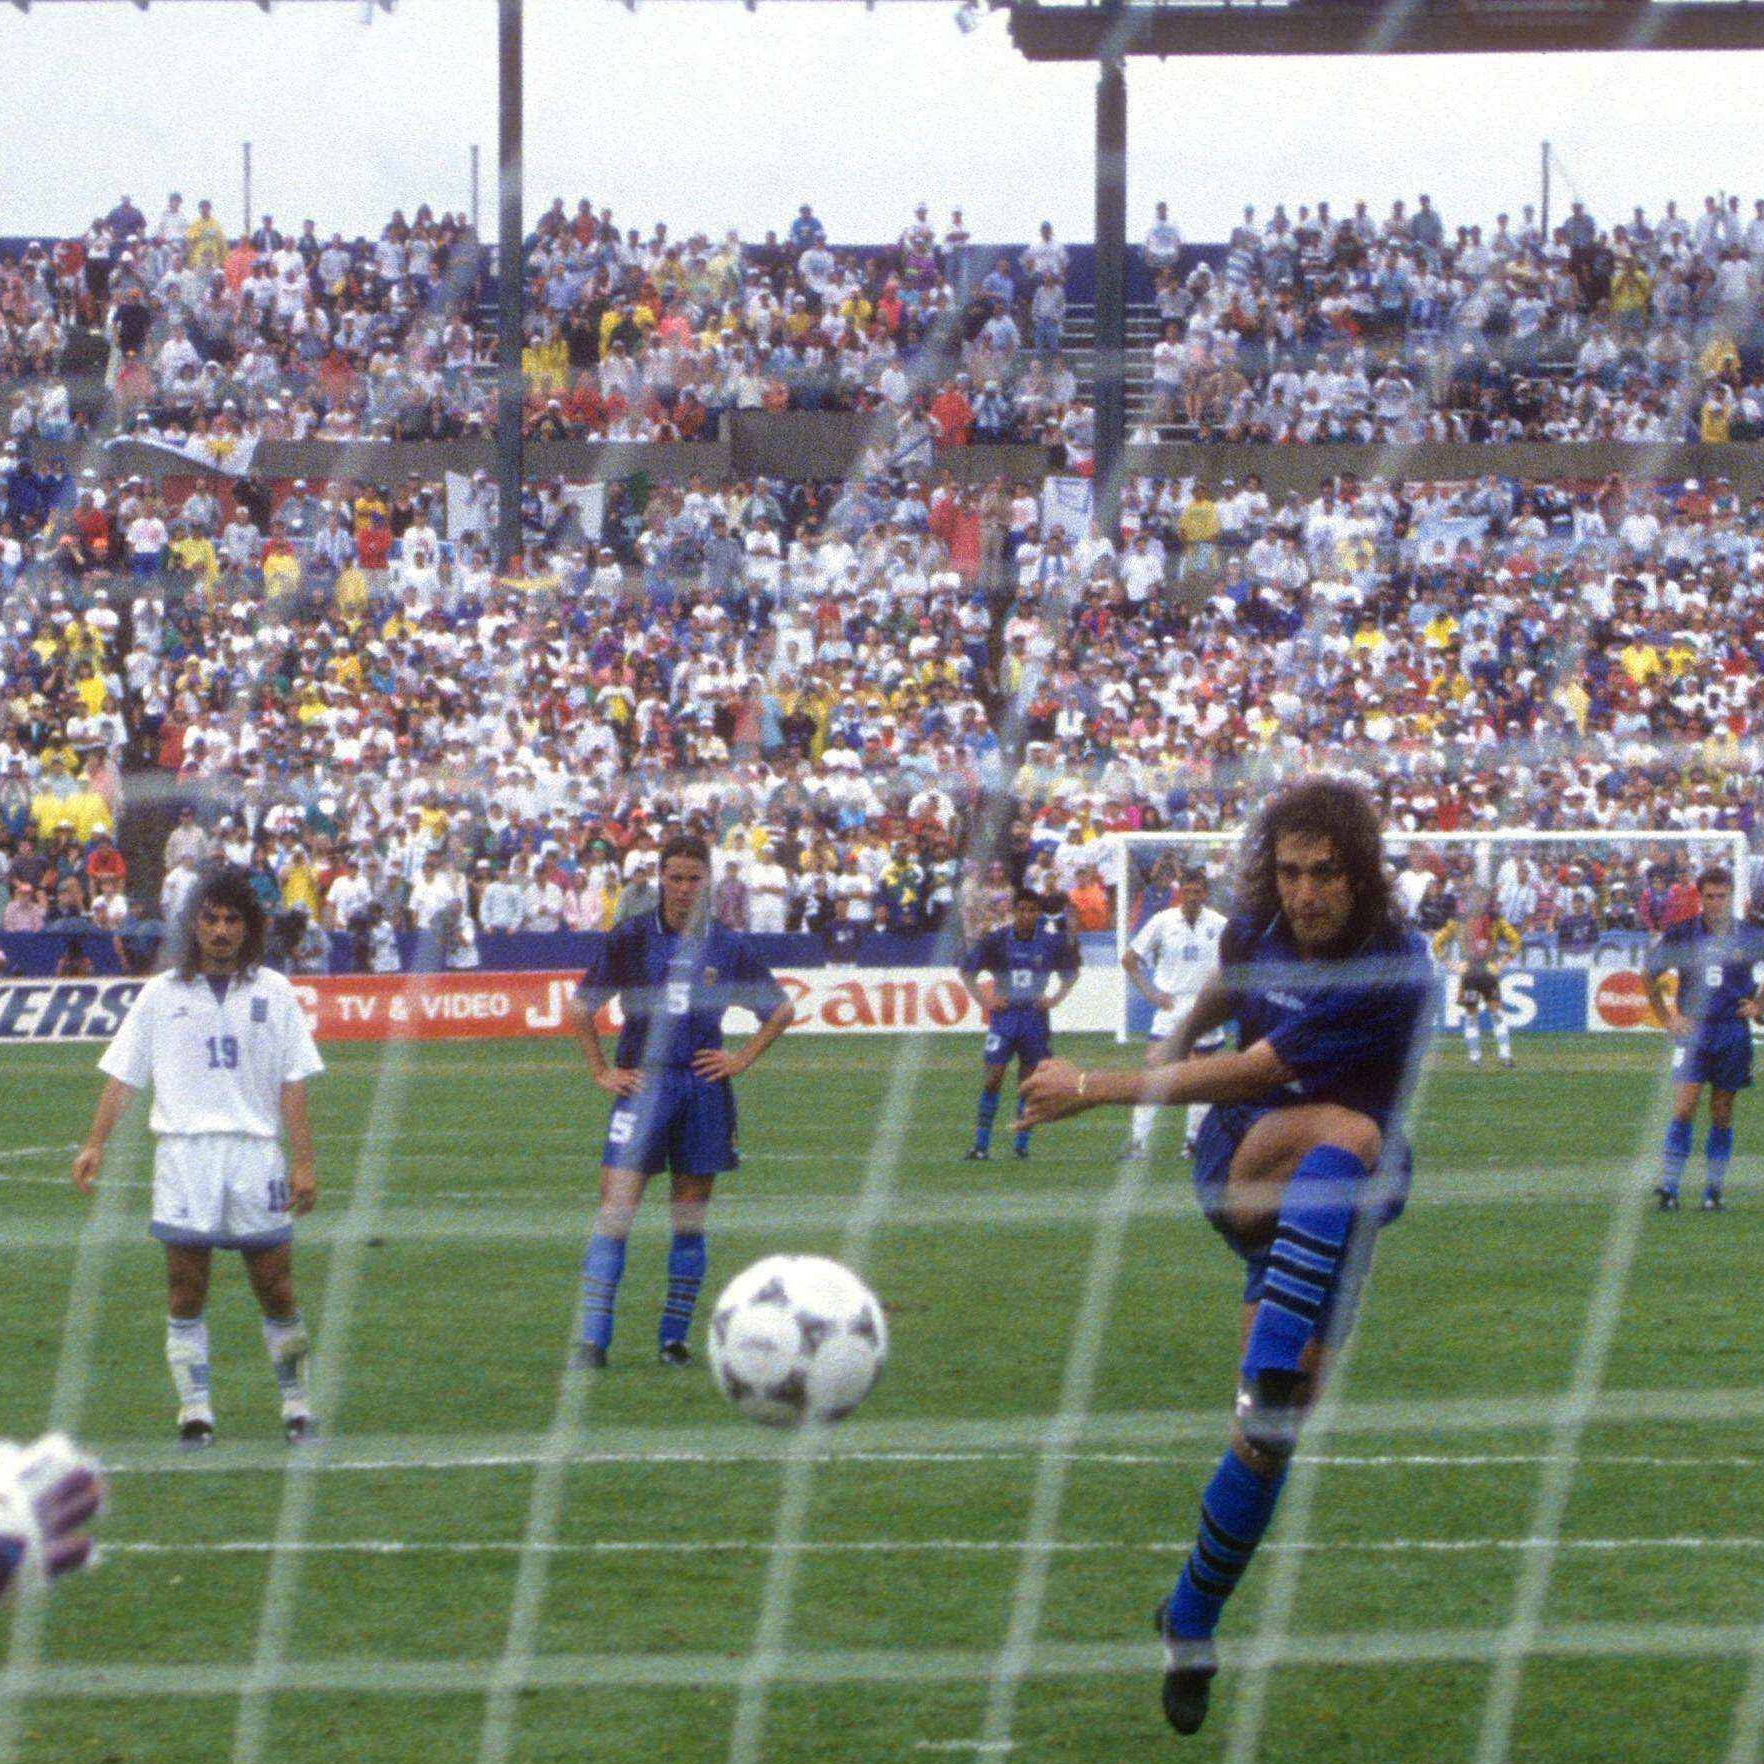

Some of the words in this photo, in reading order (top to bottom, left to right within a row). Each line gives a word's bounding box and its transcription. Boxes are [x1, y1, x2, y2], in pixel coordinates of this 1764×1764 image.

[1704, 965, 1724, 987] 6
[338, 994, 377, 1021] TV
[419, 992, 511, 1021] VIDEO
[206, 1035, 238, 1070] 19
